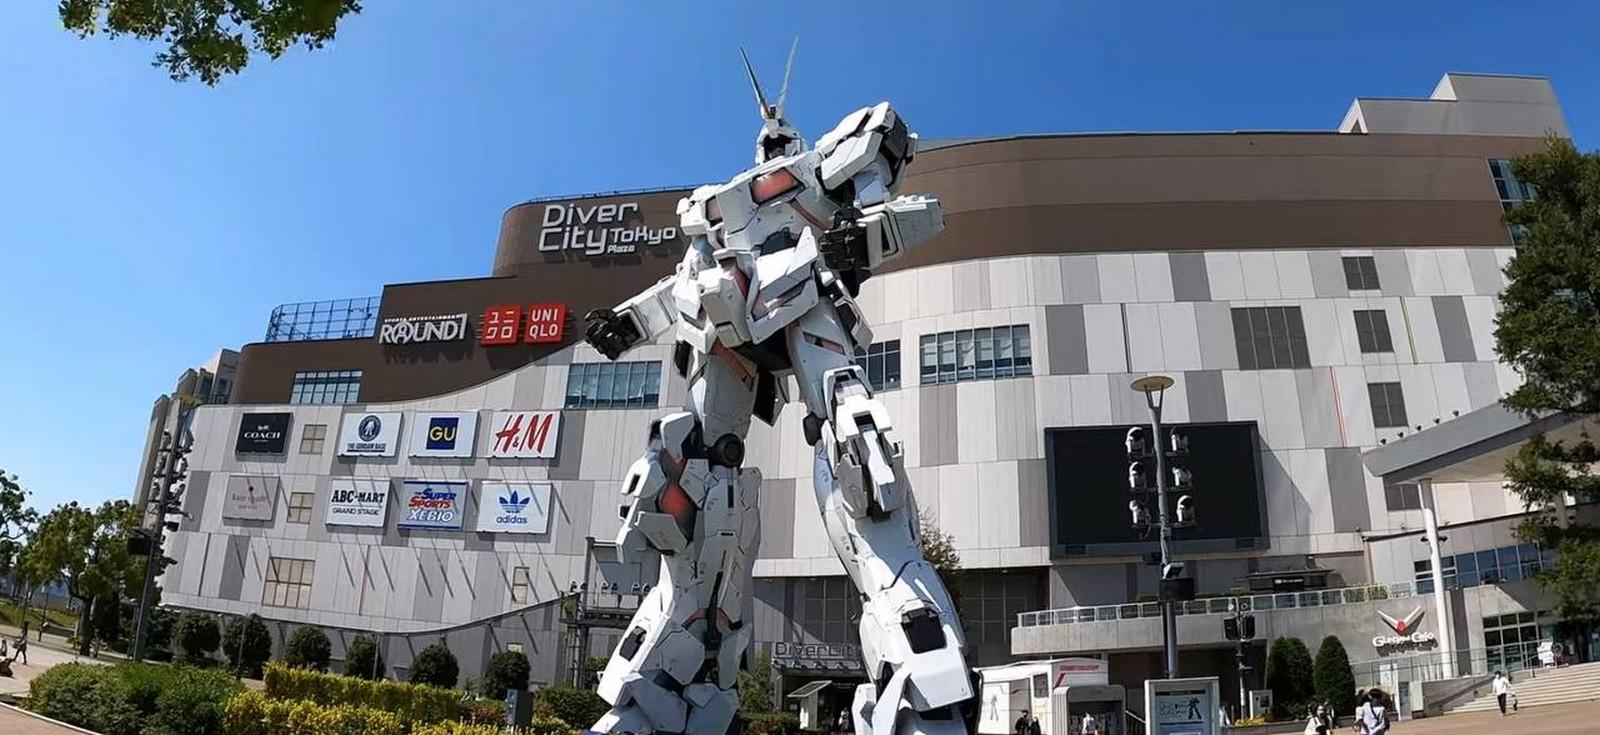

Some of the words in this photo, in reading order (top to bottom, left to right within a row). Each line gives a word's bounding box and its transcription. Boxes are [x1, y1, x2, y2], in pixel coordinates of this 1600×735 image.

[542, 202, 638, 227] Diver
[539, 225, 607, 255] City
[607, 245, 635, 254] Plaza
[531, 308, 558, 322] UNI
[529, 323, 559, 340] QLO
[244, 431, 281, 440] COACH
[429, 426, 457, 442] GU
[493, 413, 554, 454] H&M
[331, 489, 386, 504] ABC-MART
[332, 507, 357, 515] GRAND
[357, 508, 381, 516] STAGE
[409, 508, 454, 522] XEBIO
[496, 515, 528, 525] adidas
